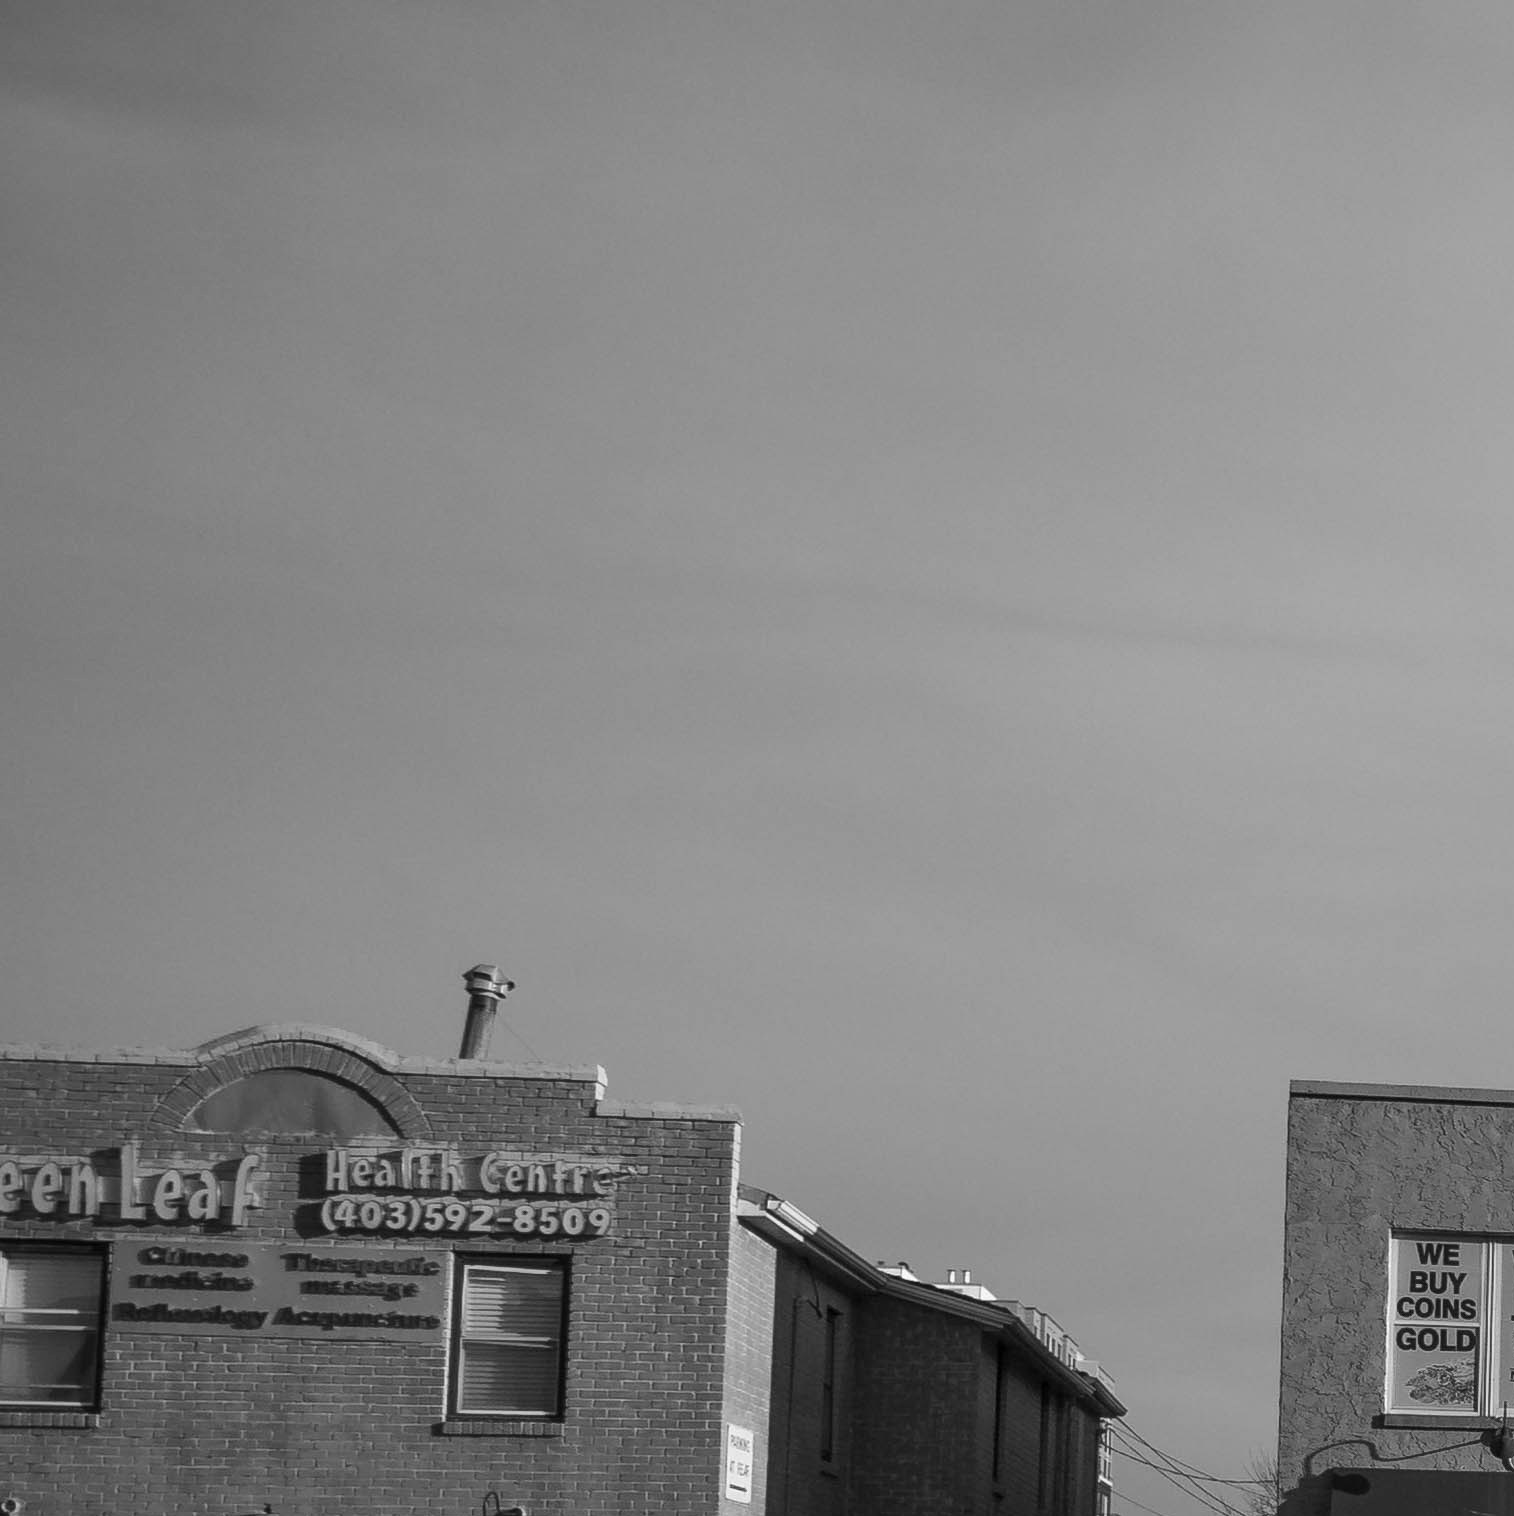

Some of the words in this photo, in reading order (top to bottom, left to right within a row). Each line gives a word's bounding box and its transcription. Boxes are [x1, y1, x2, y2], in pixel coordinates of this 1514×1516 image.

[326, 1149, 463, 1192] Health
[480, 1151, 619, 1194] Centre
[121, 1143, 261, 1228] Leaf
[320, 1199, 611, 1236] (403)592-8509
[1416, 1243, 1460, 1266] WE
[1409, 1271, 1467, 1293] BUY
[1396, 1297, 1477, 1319] COINS
[1396, 1328, 1477, 1352] GOLD
